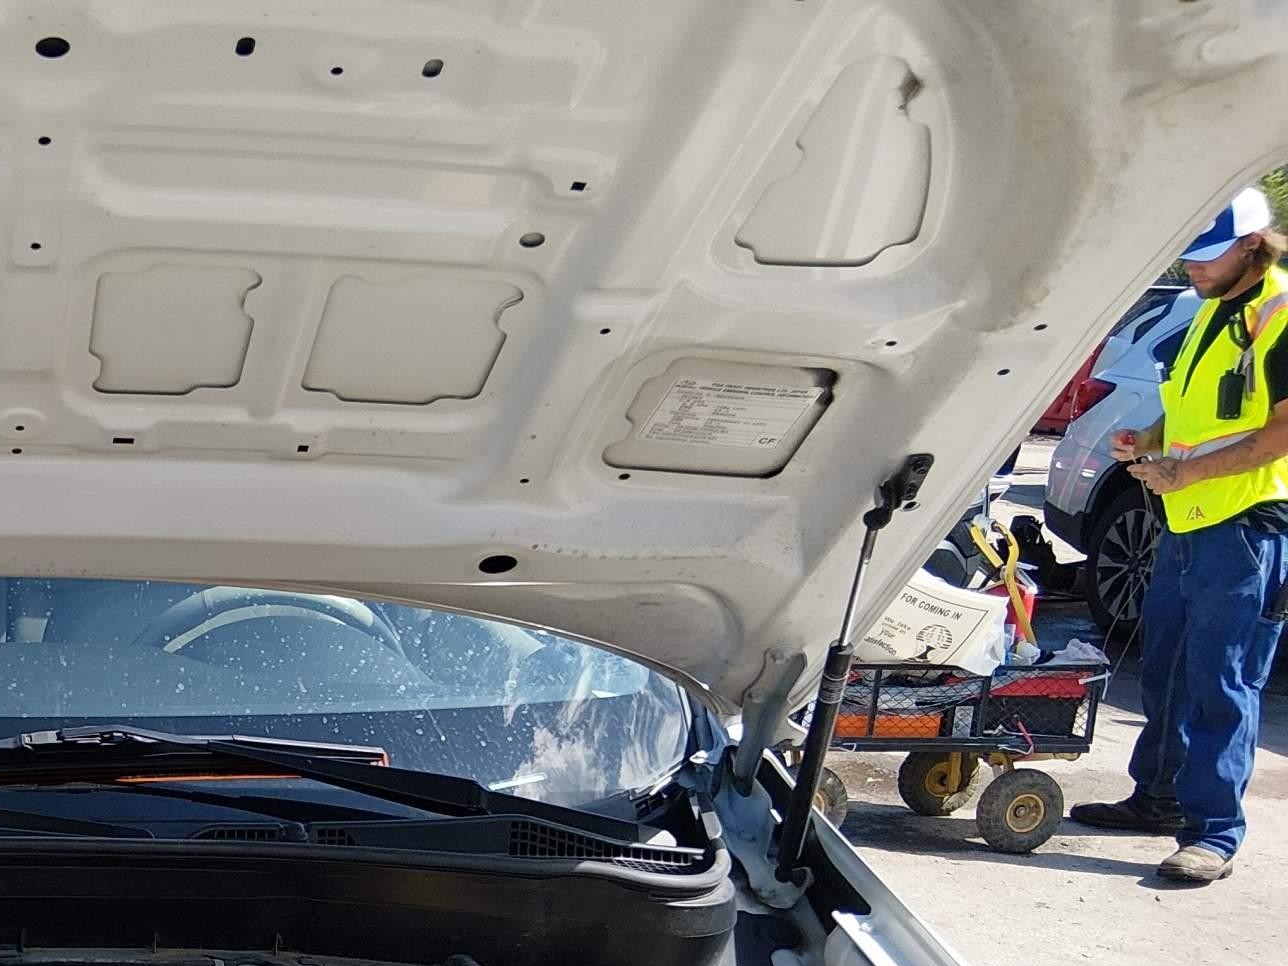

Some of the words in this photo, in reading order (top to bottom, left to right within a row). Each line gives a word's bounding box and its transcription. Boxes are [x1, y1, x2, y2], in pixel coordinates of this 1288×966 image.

[758, 436, 777, 446] CF
[901, 593, 918, 605] FOR
[918, 600, 951, 618] COMING
[952, 611, 964, 621] IN
[898, 621, 912, 630] take
[879, 628, 896, 639] your
